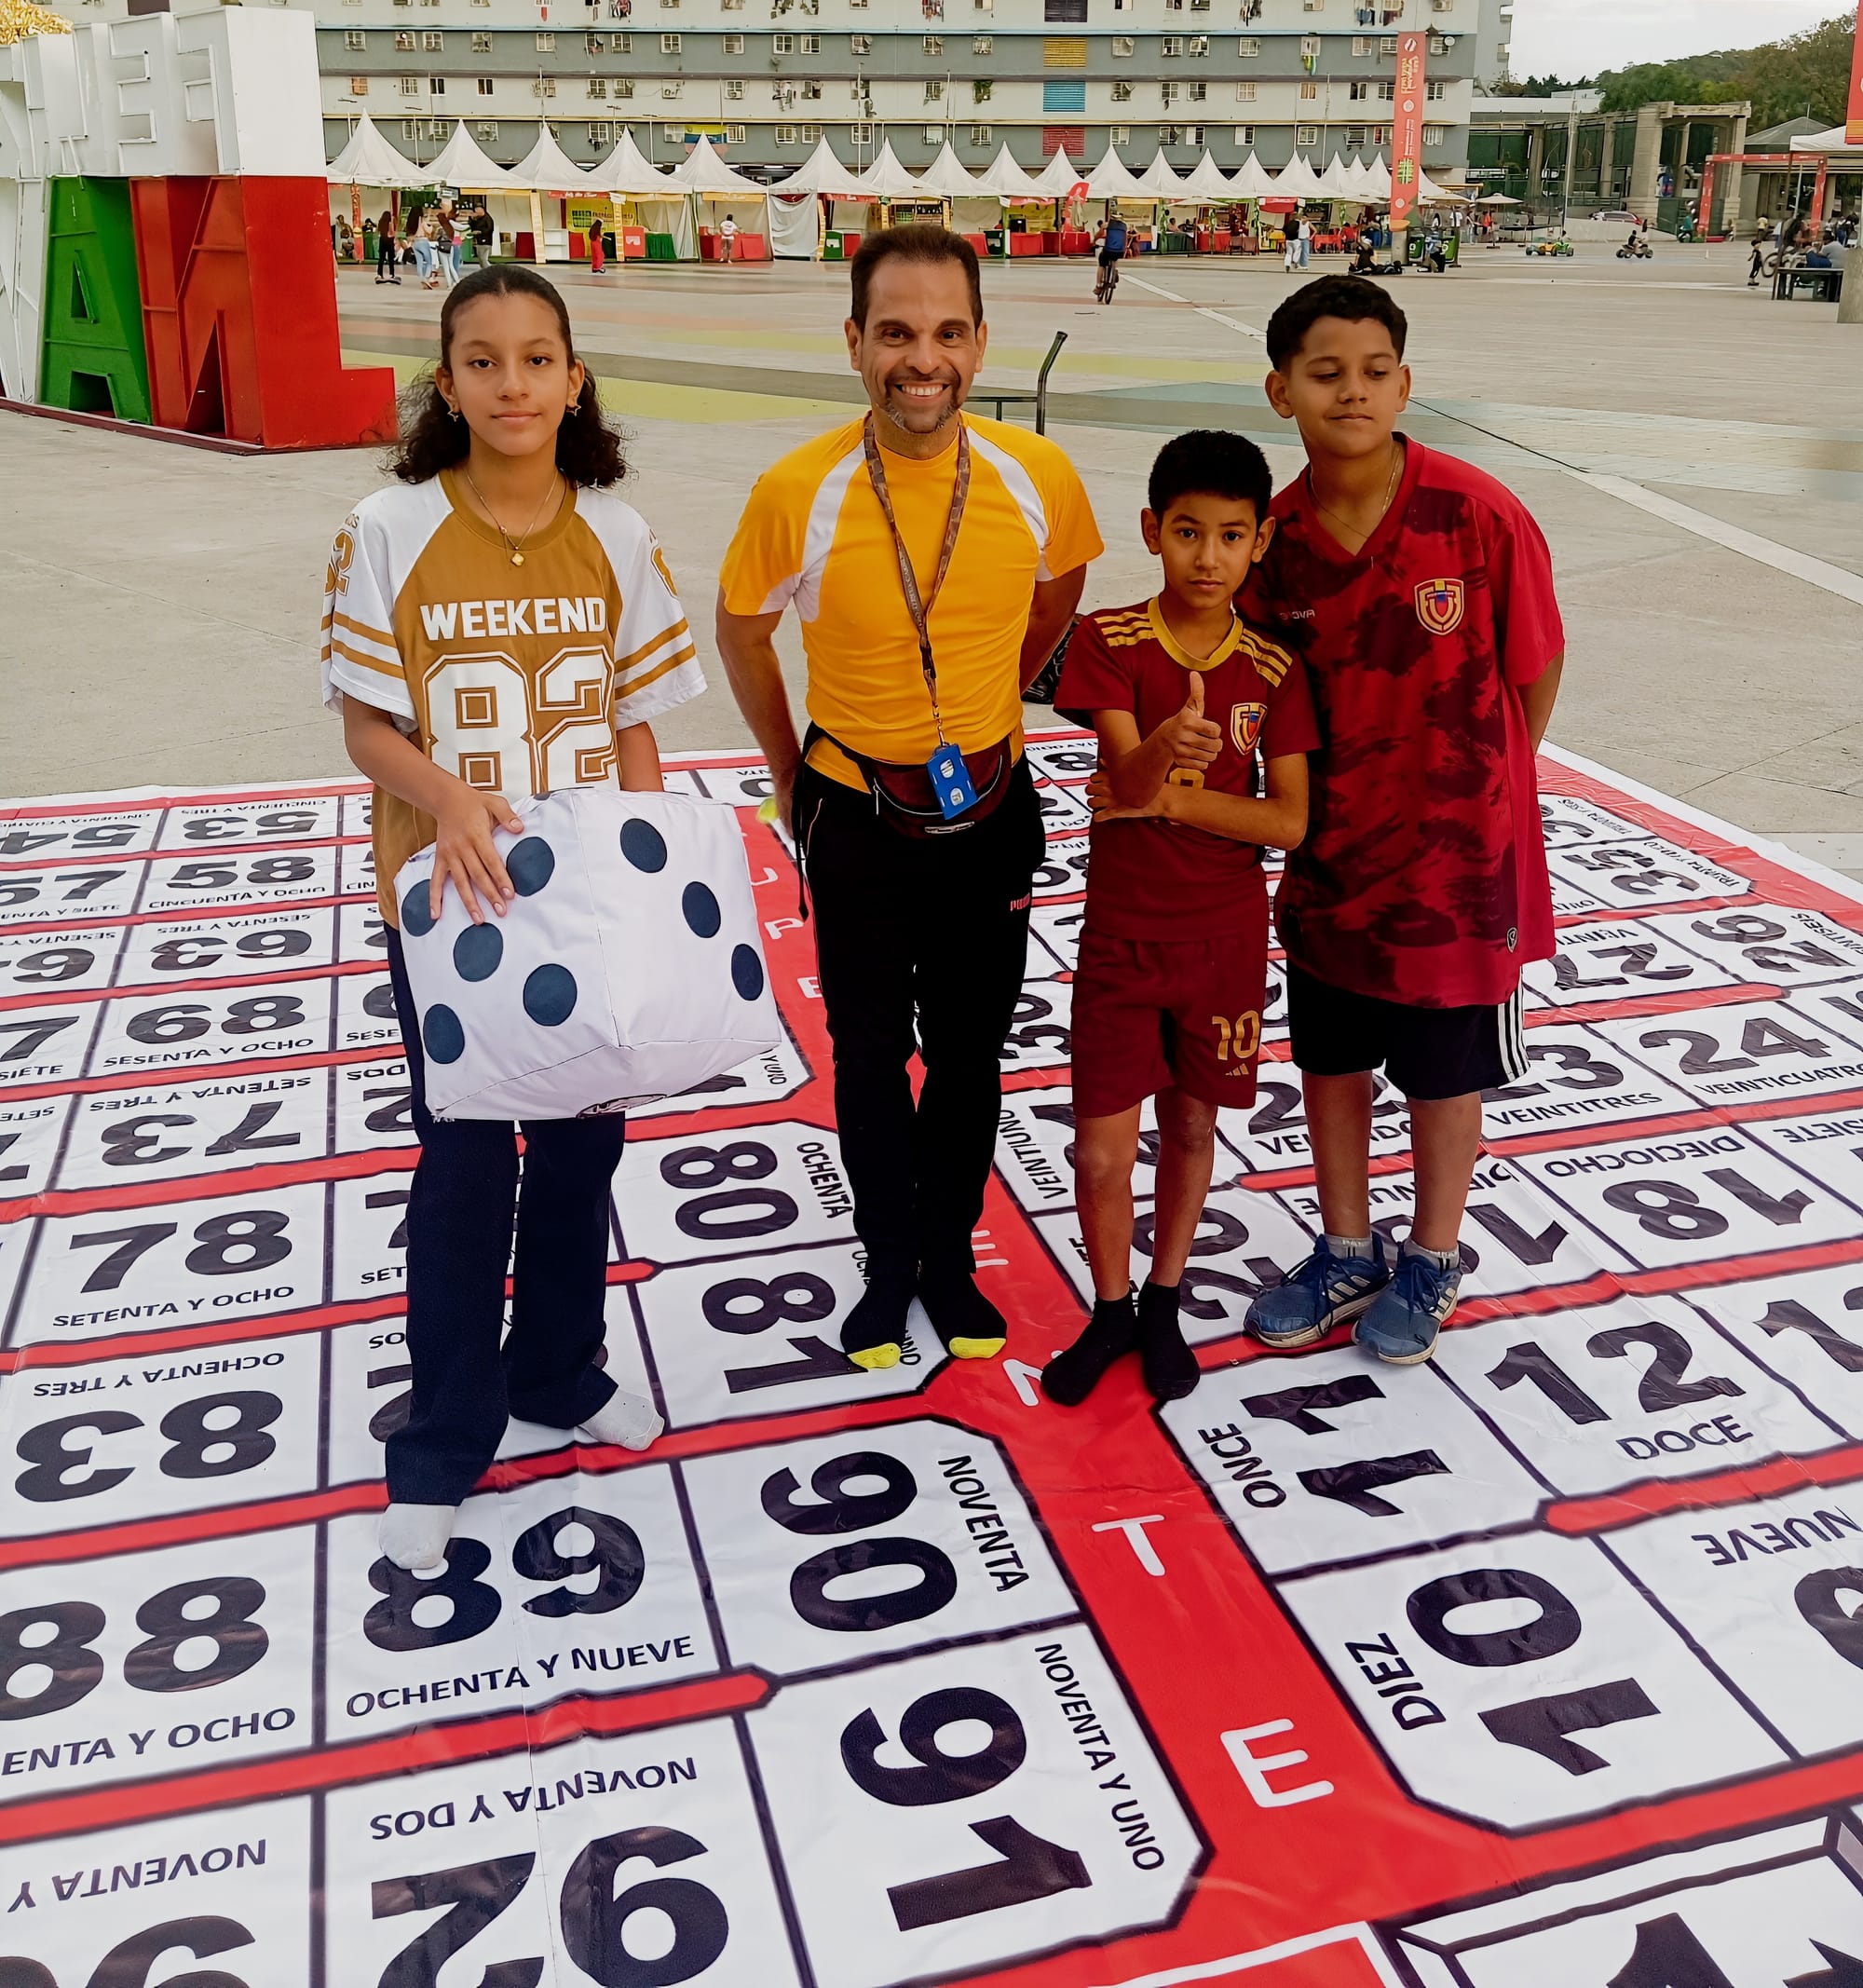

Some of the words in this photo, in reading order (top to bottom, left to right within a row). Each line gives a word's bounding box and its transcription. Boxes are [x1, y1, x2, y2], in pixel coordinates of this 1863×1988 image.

[419, 597, 606, 641] WEEKEND
[423, 645, 620, 797] 82
[0, 824, 142, 855] 54
[184, 810, 320, 840] 53
[0, 870, 128, 907] 57
[166, 855, 316, 890] 58
[1561, 849, 1701, 895] 35
[149, 892, 252, 909] CINCUENTA
[257, 889, 270, 898] Y
[274, 886, 326, 897] OCHO
[227, 913, 311, 929] SESENTA
[29, 932, 116, 946] SESENTA
[151, 929, 313, 972] 63
[156, 924, 203, 935] TRES
[209, 922, 222, 932] Y
[1555, 928, 1639, 946] VEINTI
[1691, 914, 1856, 973] 26
[1548, 942, 1694, 991] 27
[126, 995, 306, 1045] 68
[347, 1028, 400, 1043] SESE
[1212, 1010, 1259, 1061] 10
[103, 1050, 212, 1068] SESENTA
[219, 1046, 234, 1055] Y
[241, 1038, 315, 1052] OCHO
[1639, 1016, 1832, 1075] 24
[0, 1064, 64, 1081] SIETE
[193, 1077, 312, 1097] SETENTA
[347, 1064, 406, 1082] DOS
[89, 1096, 151, 1113] TRES
[166, 1091, 184, 1104] Y
[1486, 1092, 1663, 1126] VEINTITRES
[100, 1099, 302, 1167] 73
[1772, 1117, 1863, 1144] SIETE
[796, 1141, 853, 1219] OCHENTA
[1543, 1135, 1746, 1178] DIECIOCHO
[660, 1140, 799, 1240] 80
[1602, 1167, 1816, 1240] 18
[69, 1209, 292, 1294] 78
[53, 1301, 180, 1327] SETENTA
[187, 1297, 206, 1312] Y
[212, 1286, 295, 1308] OCHO
[1752, 1287, 1863, 1373] 1
[701, 1271, 869, 1394] 81
[33, 1376, 106, 1397] TRES
[115, 1373, 132, 1389] Y
[143, 1352, 285, 1385] OCHENTA
[1484, 1320, 1747, 1425] 12
[15, 1390, 284, 1503] 83
[1239, 1373, 1453, 1518] 11
[1615, 1414, 1754, 1461] DOCE
[1198, 1423, 1287, 1508] ONCE
[761, 1450, 958, 1632] 90
[938, 1455, 1030, 1592] NOVENTA
[1691, 1505, 1863, 1566] NUEVE
[363, 1505, 646, 1653] 89
[0, 1576, 269, 1722] 88
[1406, 1567, 1661, 1777] 10
[346, 1667, 530, 1718] OCHENTA
[537, 1653, 560, 1679] Y
[571, 1636, 696, 1671] NUEVE
[1344, 1632, 1447, 1731] DIEZ
[1034, 1643, 1117, 1772] NOVENTA
[1, 1737, 116, 1776] ENTA
[129, 1729, 156, 1755] Y
[168, 1708, 296, 1750] OCHO
[503, 1757, 698, 1812] NOVENTA
[1098, 1772, 1132, 1793] Y
[369, 1801, 456, 1841] DOS
[469, 1794, 496, 1824] Y
[839, 1686, 1093, 1932] 91
[1110, 1799, 1165, 1871] UNO
[52, 1839, 267, 1900] NOVENTA
[7, 1880, 37, 1913] Y
[371, 1824, 729, 1988] 92
